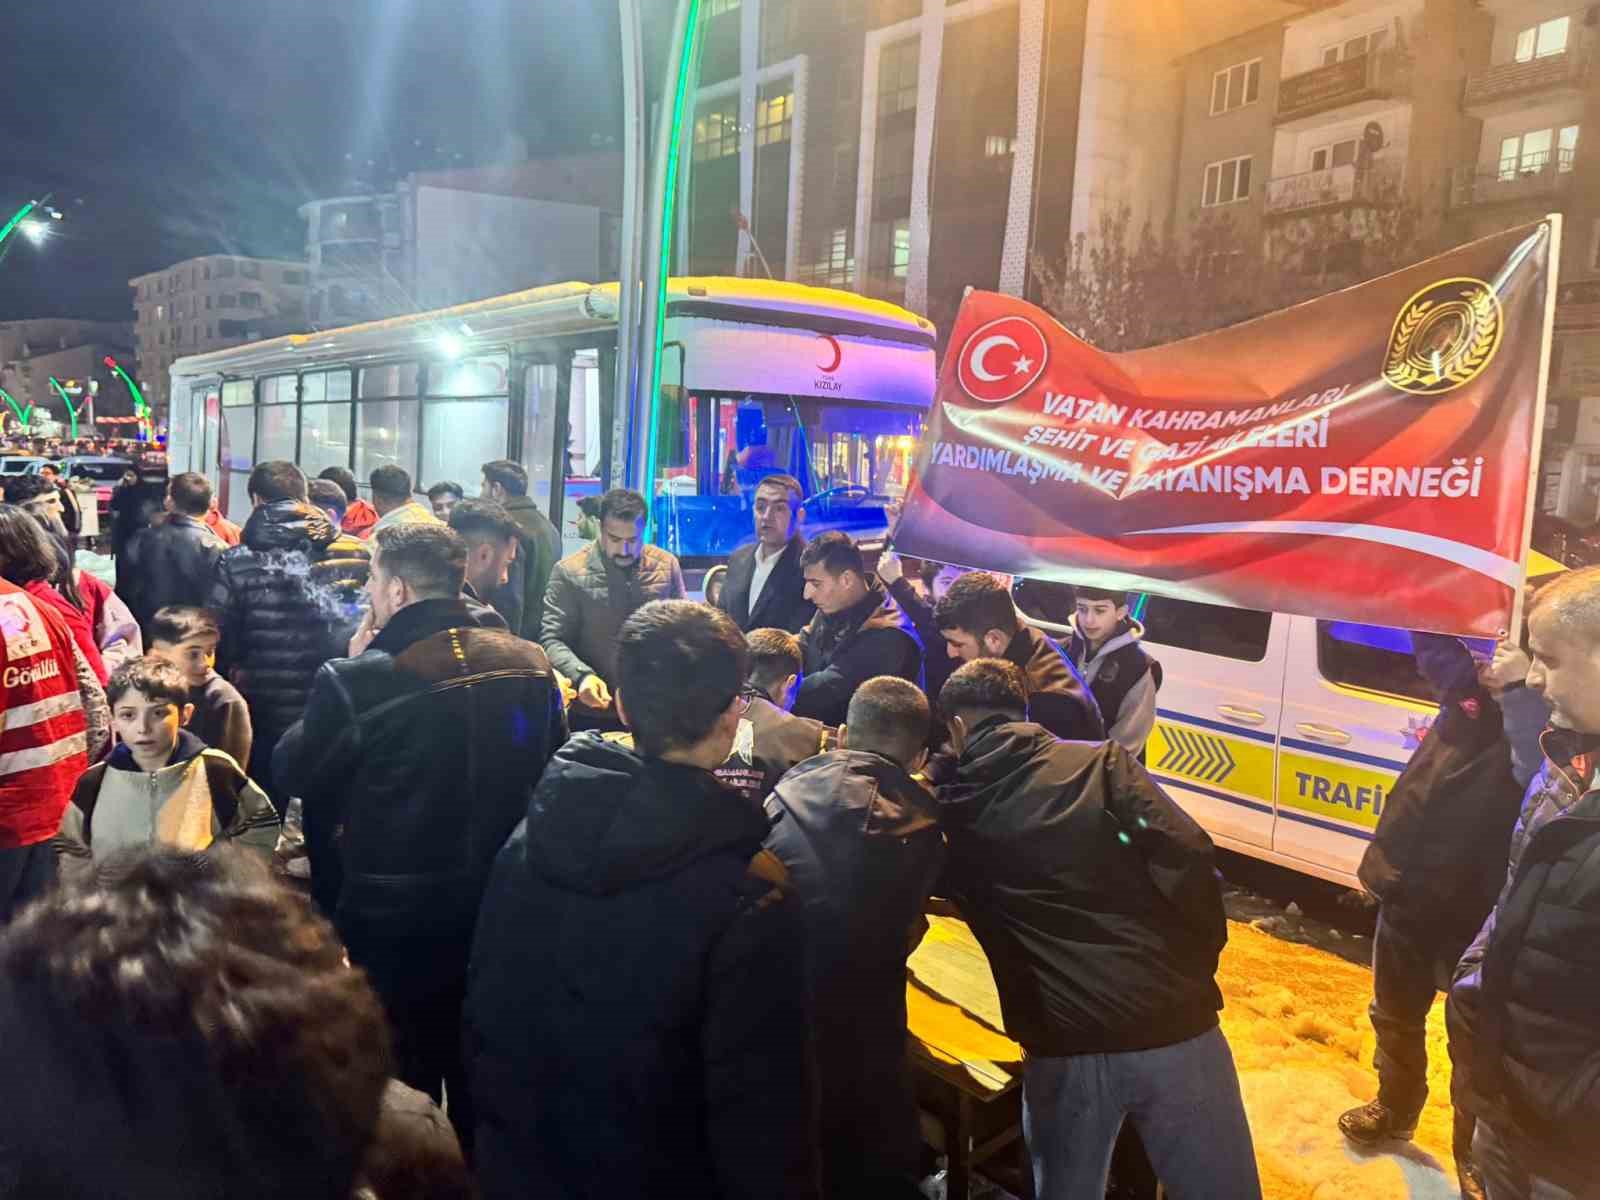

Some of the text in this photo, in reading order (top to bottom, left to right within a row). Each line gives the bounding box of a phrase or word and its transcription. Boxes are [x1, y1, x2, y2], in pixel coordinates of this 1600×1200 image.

[814, 381, 842, 392] KIZILAY
[1042, 383, 1350, 431] VATAN KAHRAMANLARI
[1023, 424, 1098, 453] ŞEHİT
[1100, 436, 1136, 459] VE
[1139, 437, 1211, 463] GAZİ
[930, 441, 1484, 501] YARDIMLAŞMA VE DAYANIŞMA DERNEĞİ
[3, 658, 60, 688] Gönüllü
[1295, 771, 1384, 816] TRAFİ
